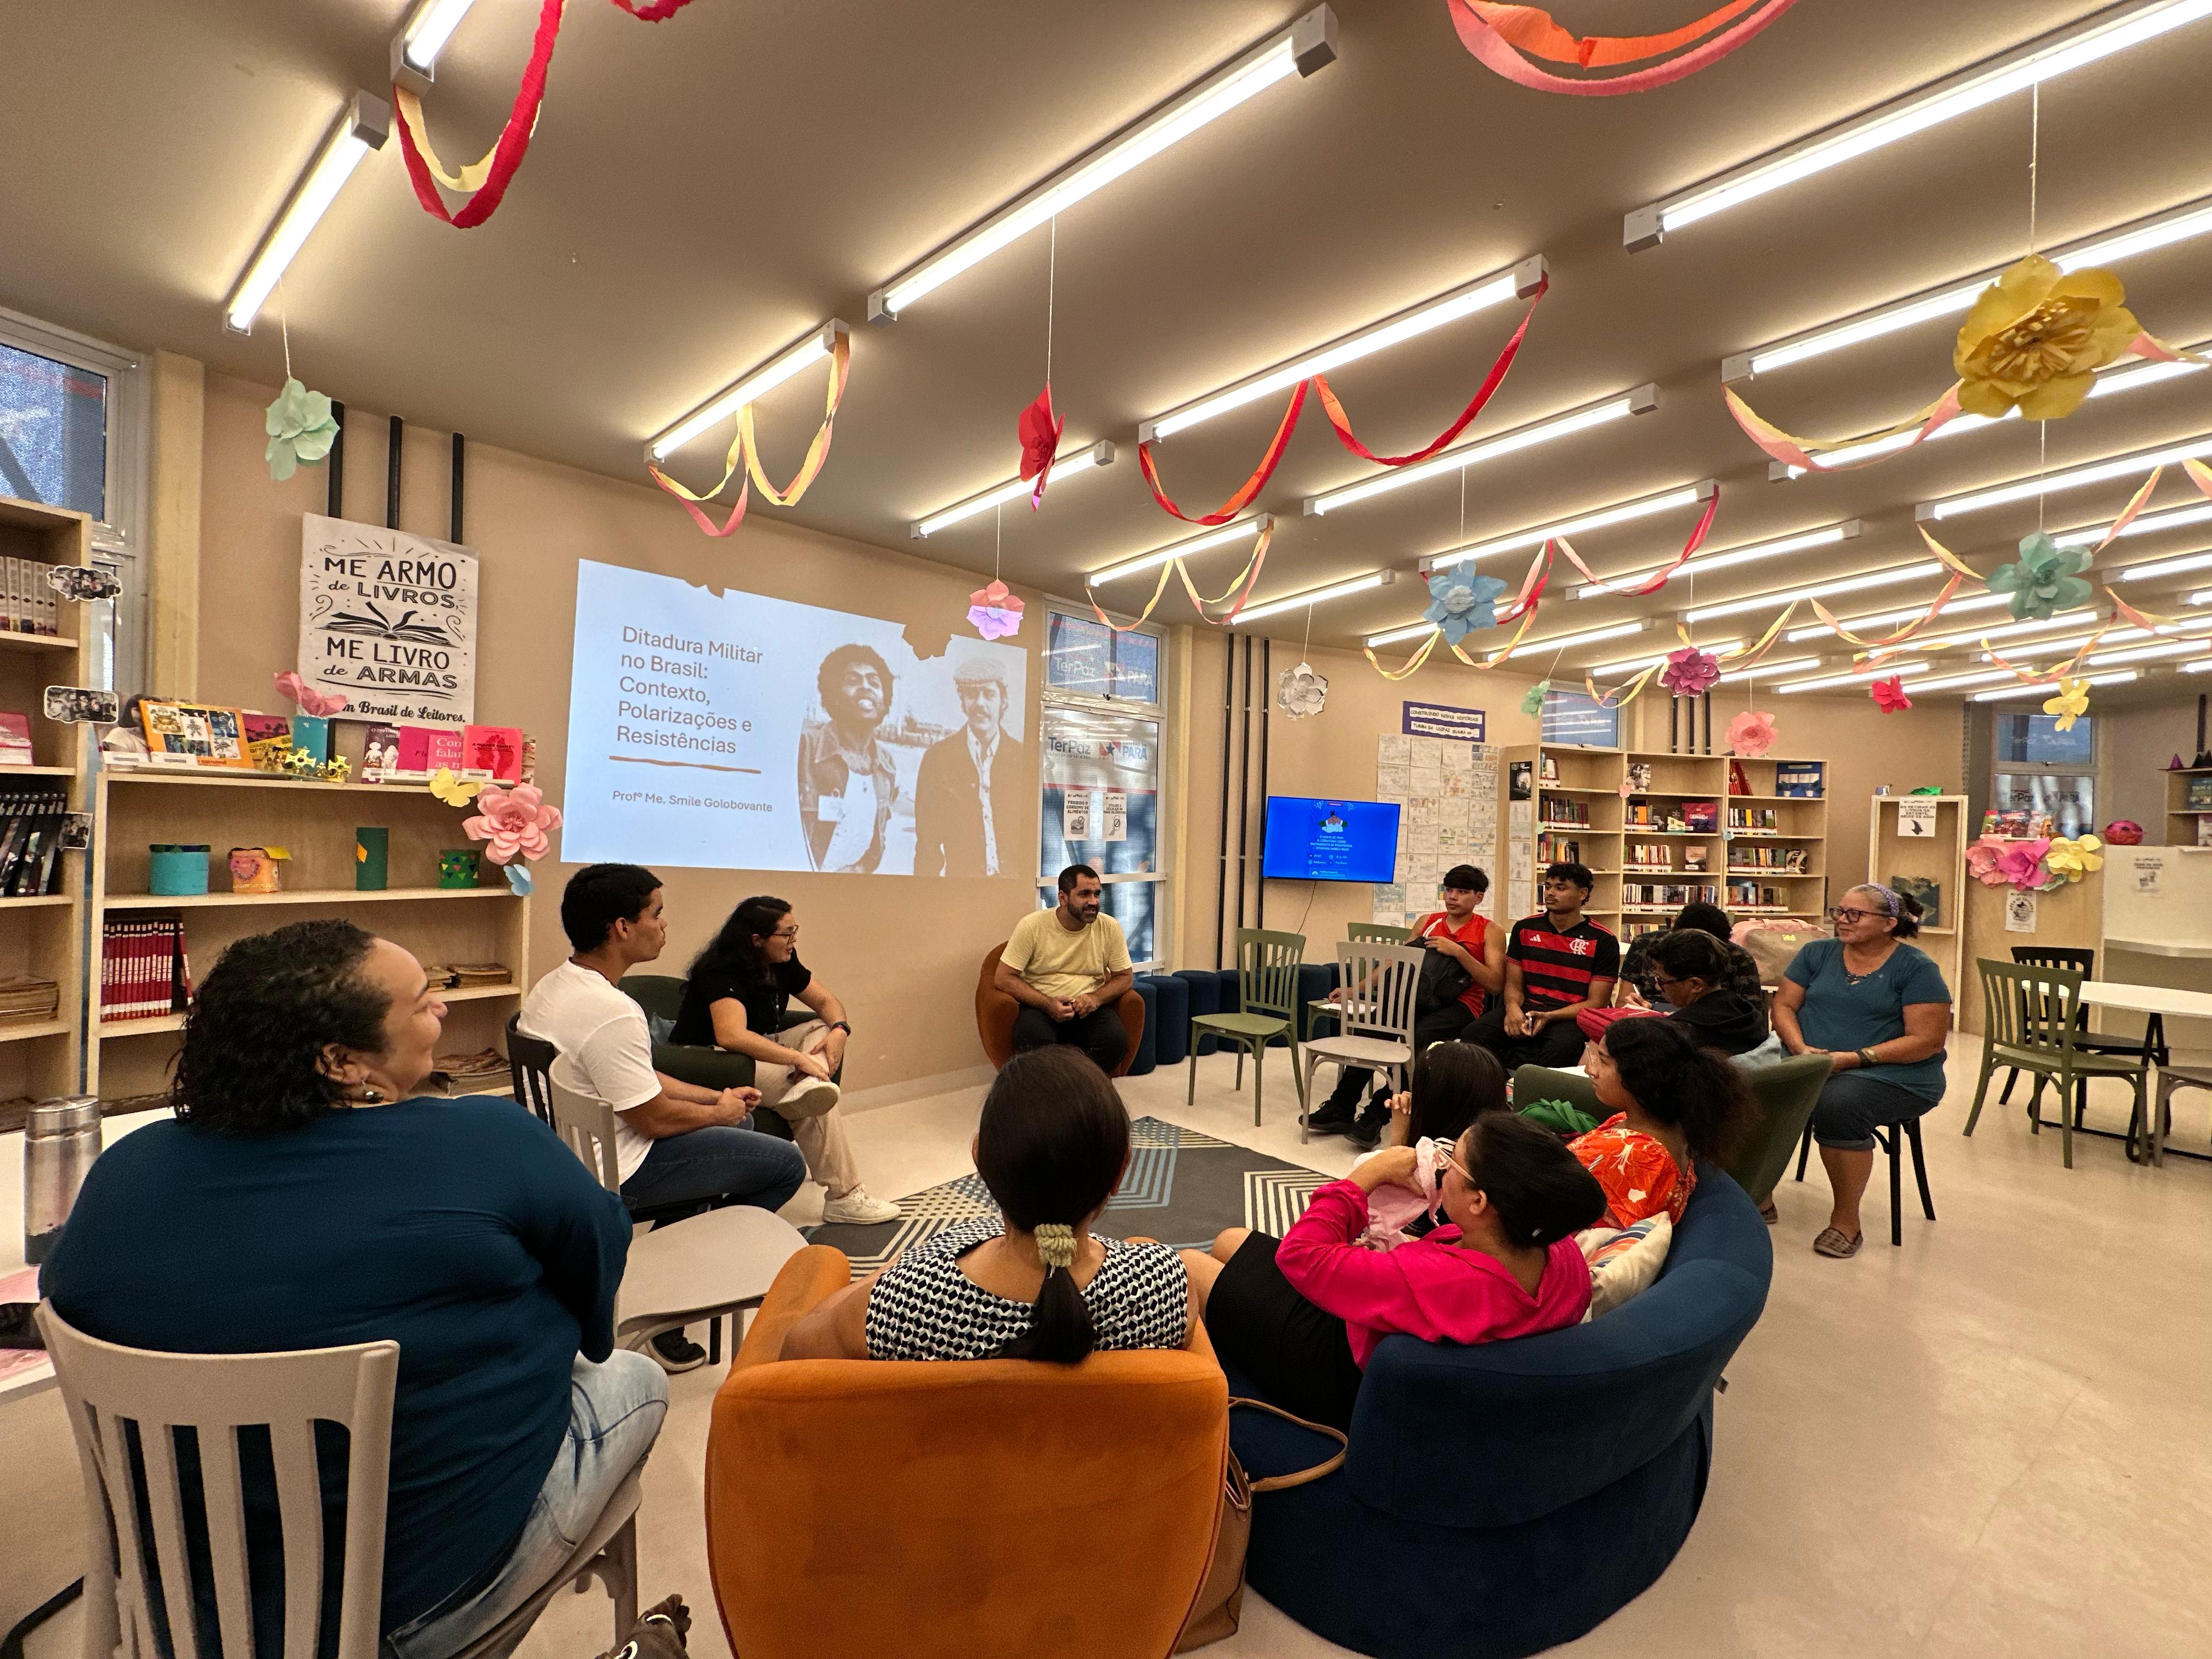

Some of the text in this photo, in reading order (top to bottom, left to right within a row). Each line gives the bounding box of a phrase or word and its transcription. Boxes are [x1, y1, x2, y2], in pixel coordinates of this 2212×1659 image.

[325, 557, 456, 589] ME ARMO
[329, 580, 459, 610] de LIVROS,
[328, 637, 449, 669] ME LIVRO
[623, 626, 763, 663] Ditadura Militar
[324, 665, 457, 689] de ARMAS
[621, 654, 708, 679] no Brasil:
[620, 676, 710, 706] Contexto,
[359, 701, 398, 716] Brasil
[400, 705, 414, 718] de
[417, 706, 466, 723] Leitores.
[618, 701, 752, 732] Polarizações e
[617, 725, 736, 753] Resistências
[1048, 737, 1091, 754] TerPaz
[645, 793, 665, 804] Me.
[669, 795, 701, 806] Smile
[704, 798, 772, 812] Golobovante
